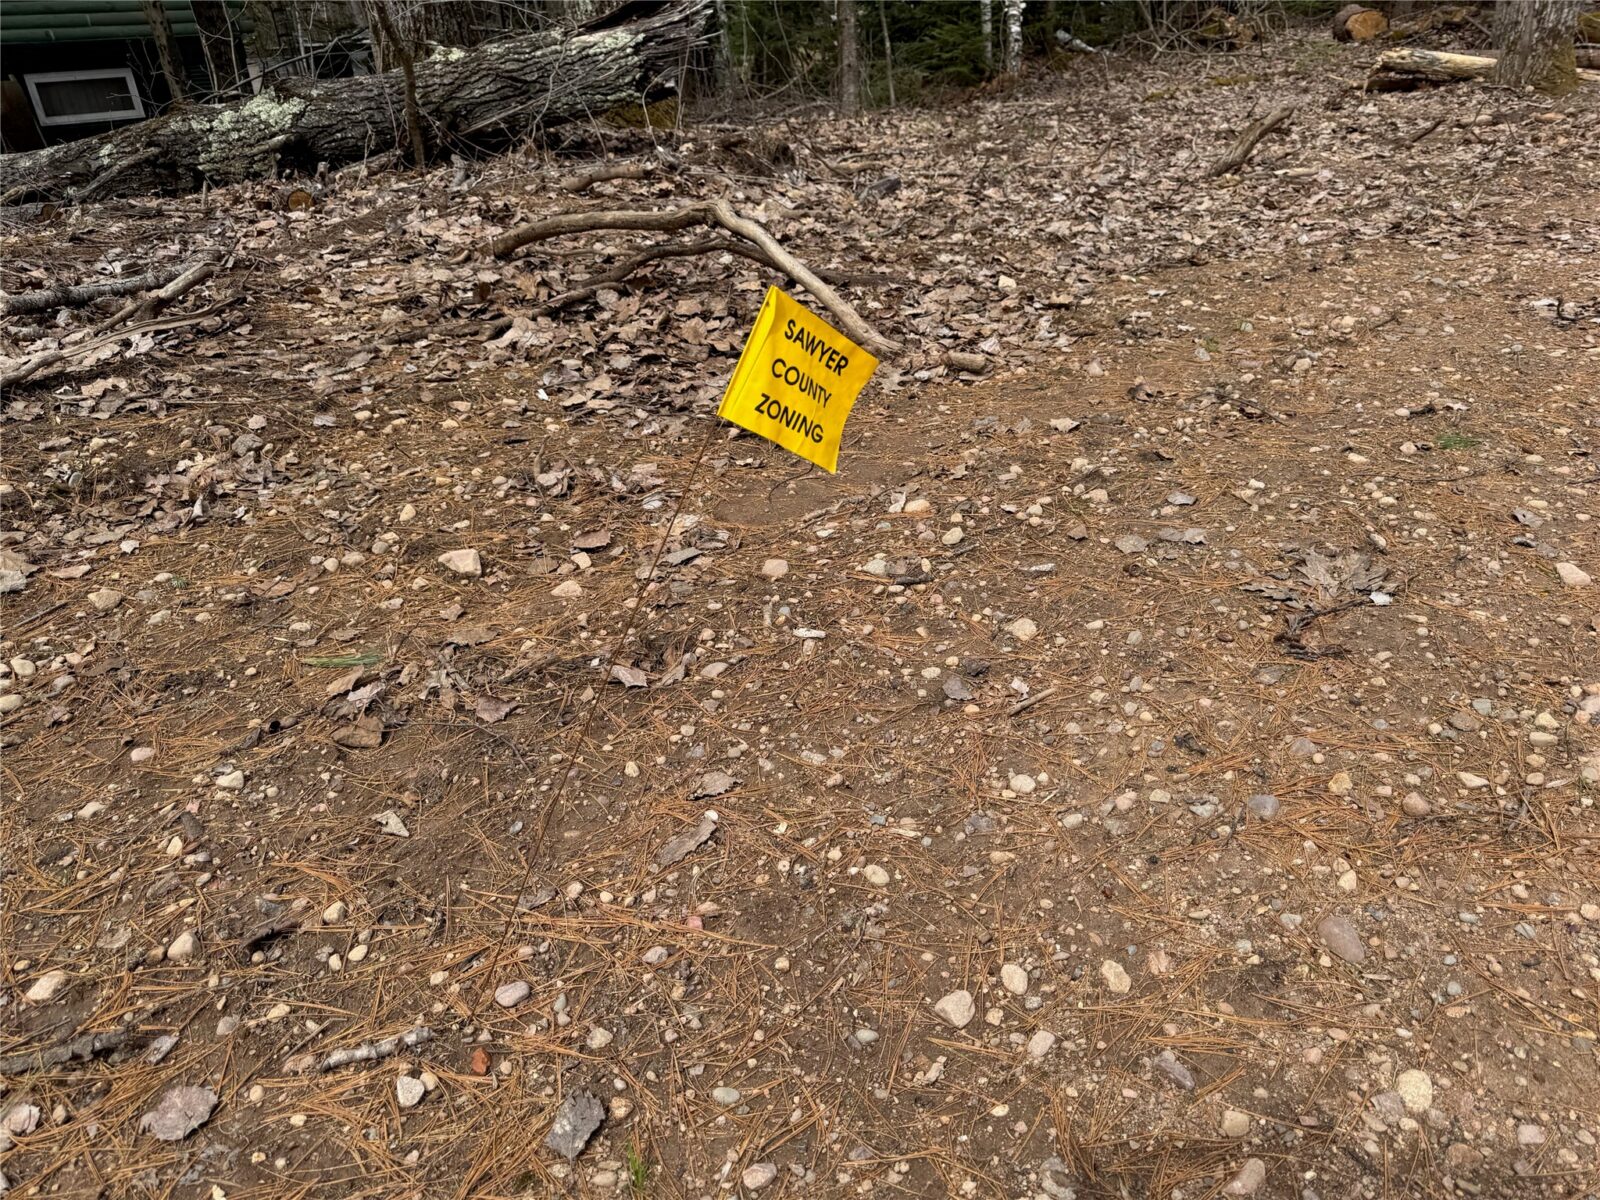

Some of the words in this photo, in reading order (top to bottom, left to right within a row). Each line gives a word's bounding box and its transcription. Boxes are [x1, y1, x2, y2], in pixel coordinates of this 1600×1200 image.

[784, 319, 849, 376] SAWYER
[771, 358, 832, 408] COUNTY
[754, 393, 824, 444] ZONING
